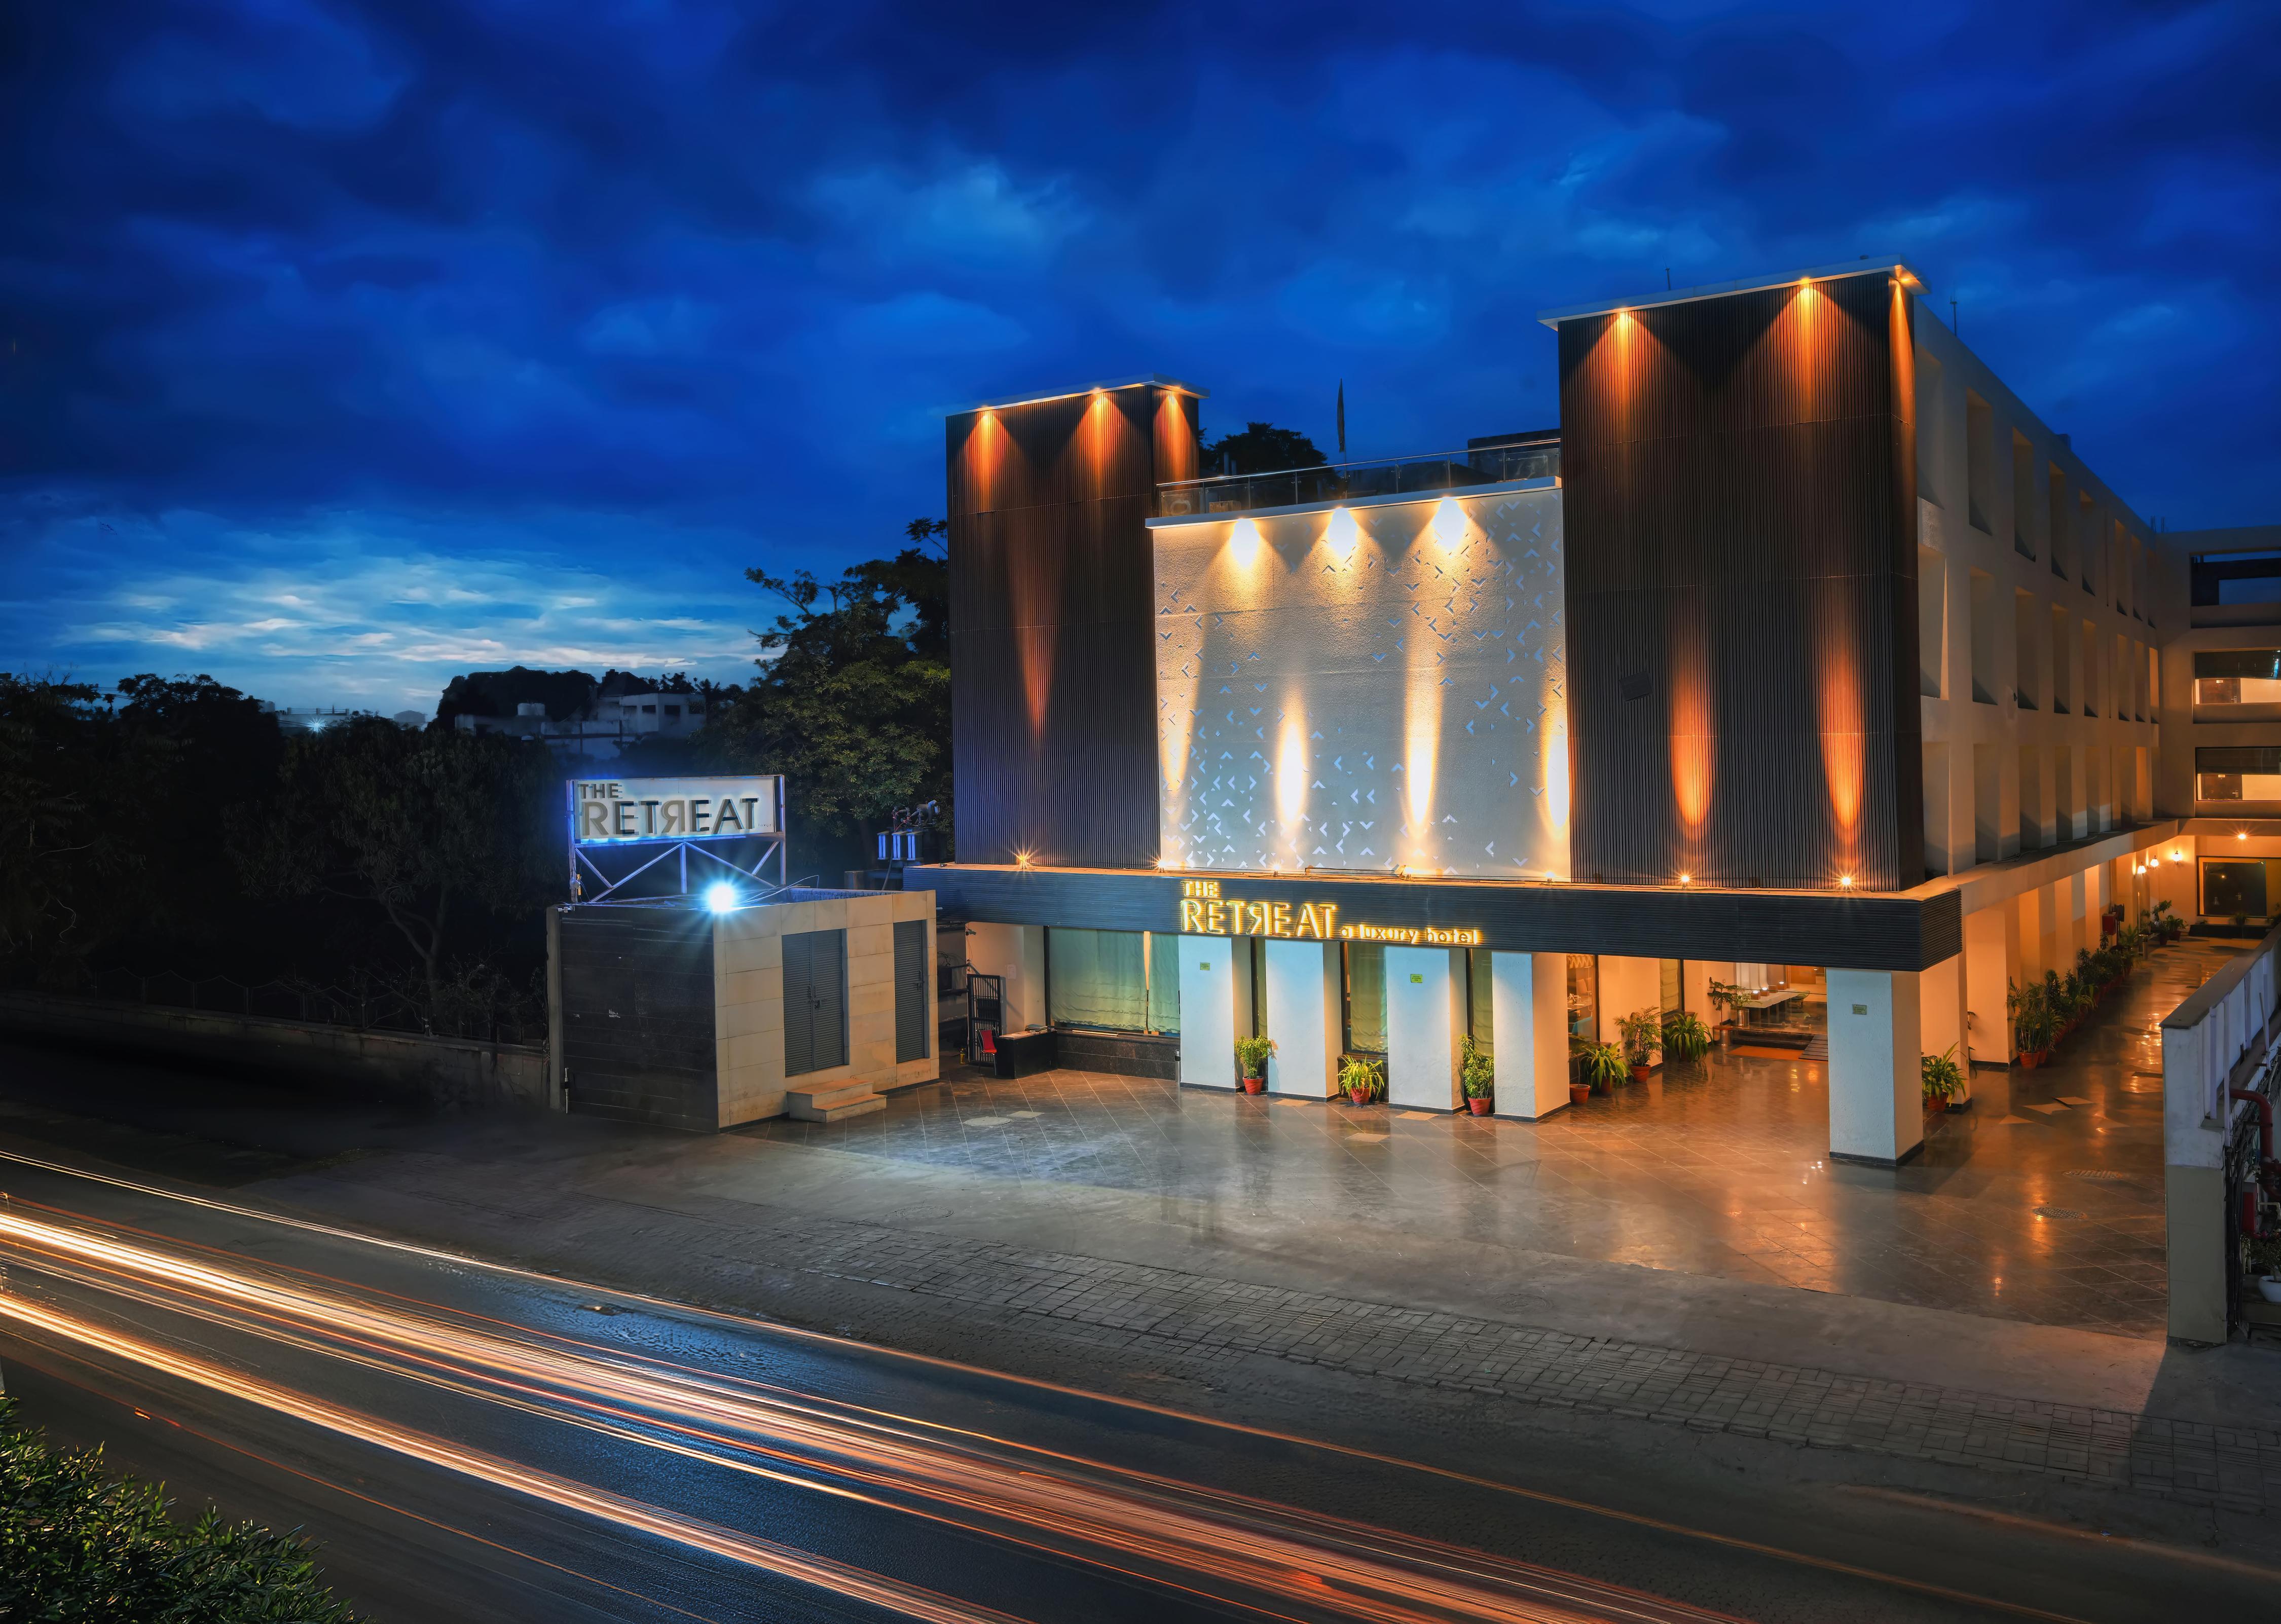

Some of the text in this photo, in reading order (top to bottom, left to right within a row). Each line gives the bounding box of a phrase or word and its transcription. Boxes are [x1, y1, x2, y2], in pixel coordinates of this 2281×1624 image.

[578, 783, 622, 799] THE
[1180, 880, 1219, 897] THE
[1341, 927, 1352, 938] a
[1359, 924, 1419, 944] luxury
[1427, 928, 1478, 944] hotel
